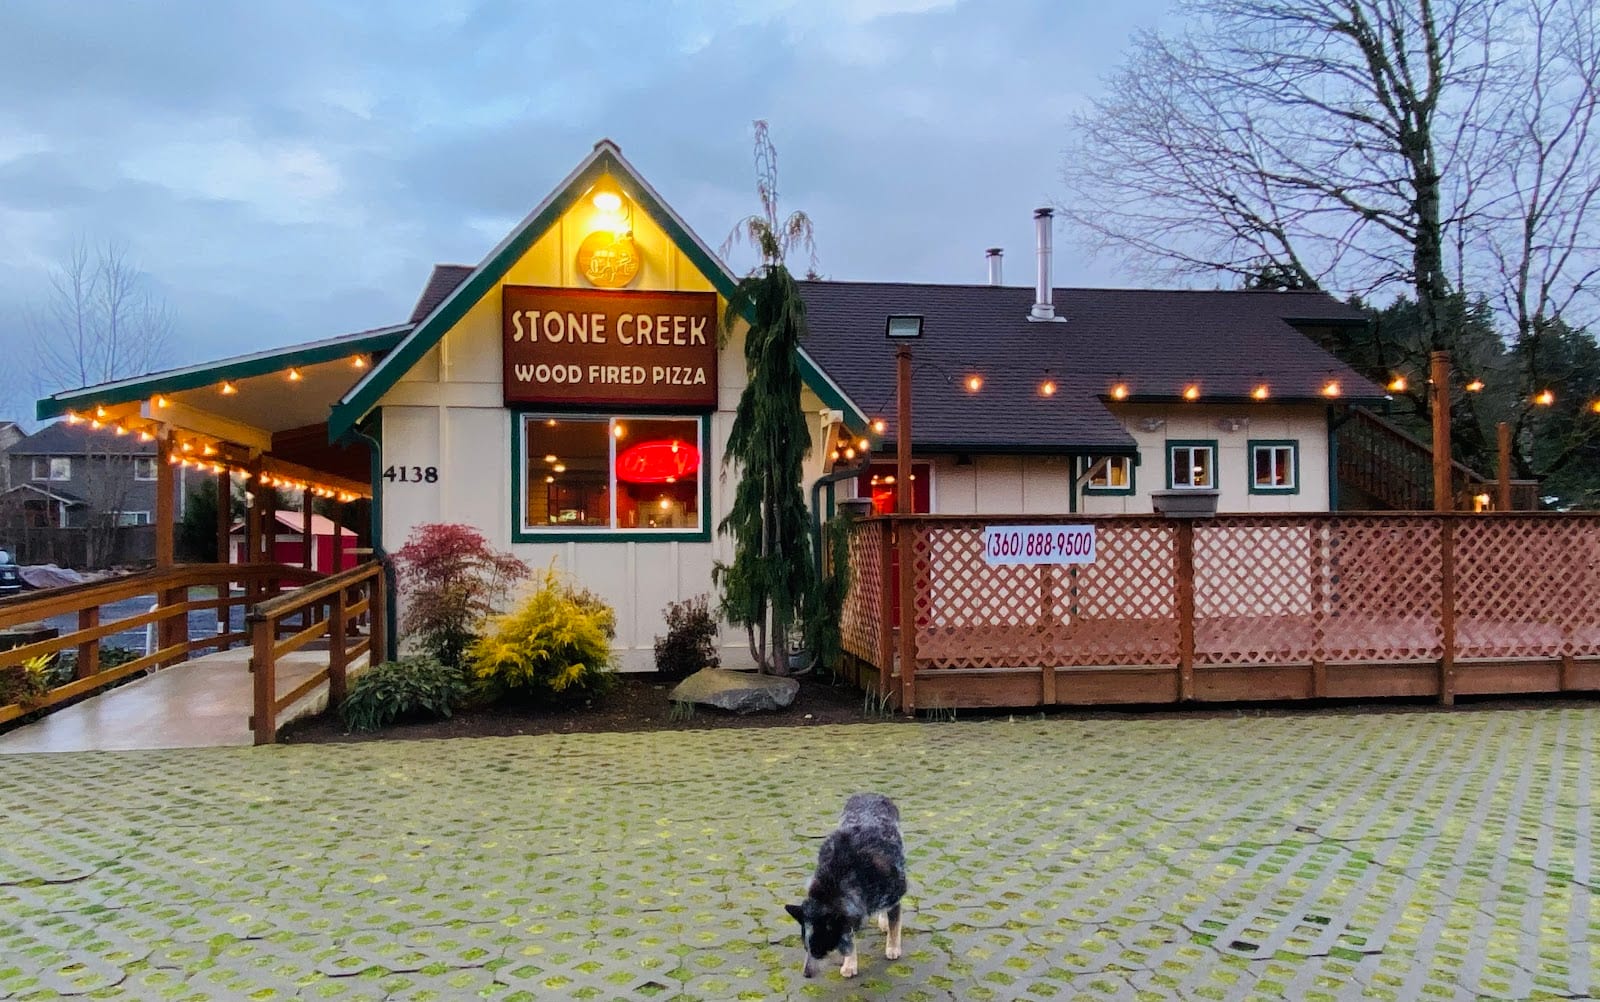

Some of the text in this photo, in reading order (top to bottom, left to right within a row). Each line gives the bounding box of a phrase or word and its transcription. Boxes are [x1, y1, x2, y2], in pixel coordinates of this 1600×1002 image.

[511, 309, 707, 346] STONE CREEK
[514, 363, 707, 385] WOOD FIRED PIZZA
[383, 465, 439, 483] 4138
